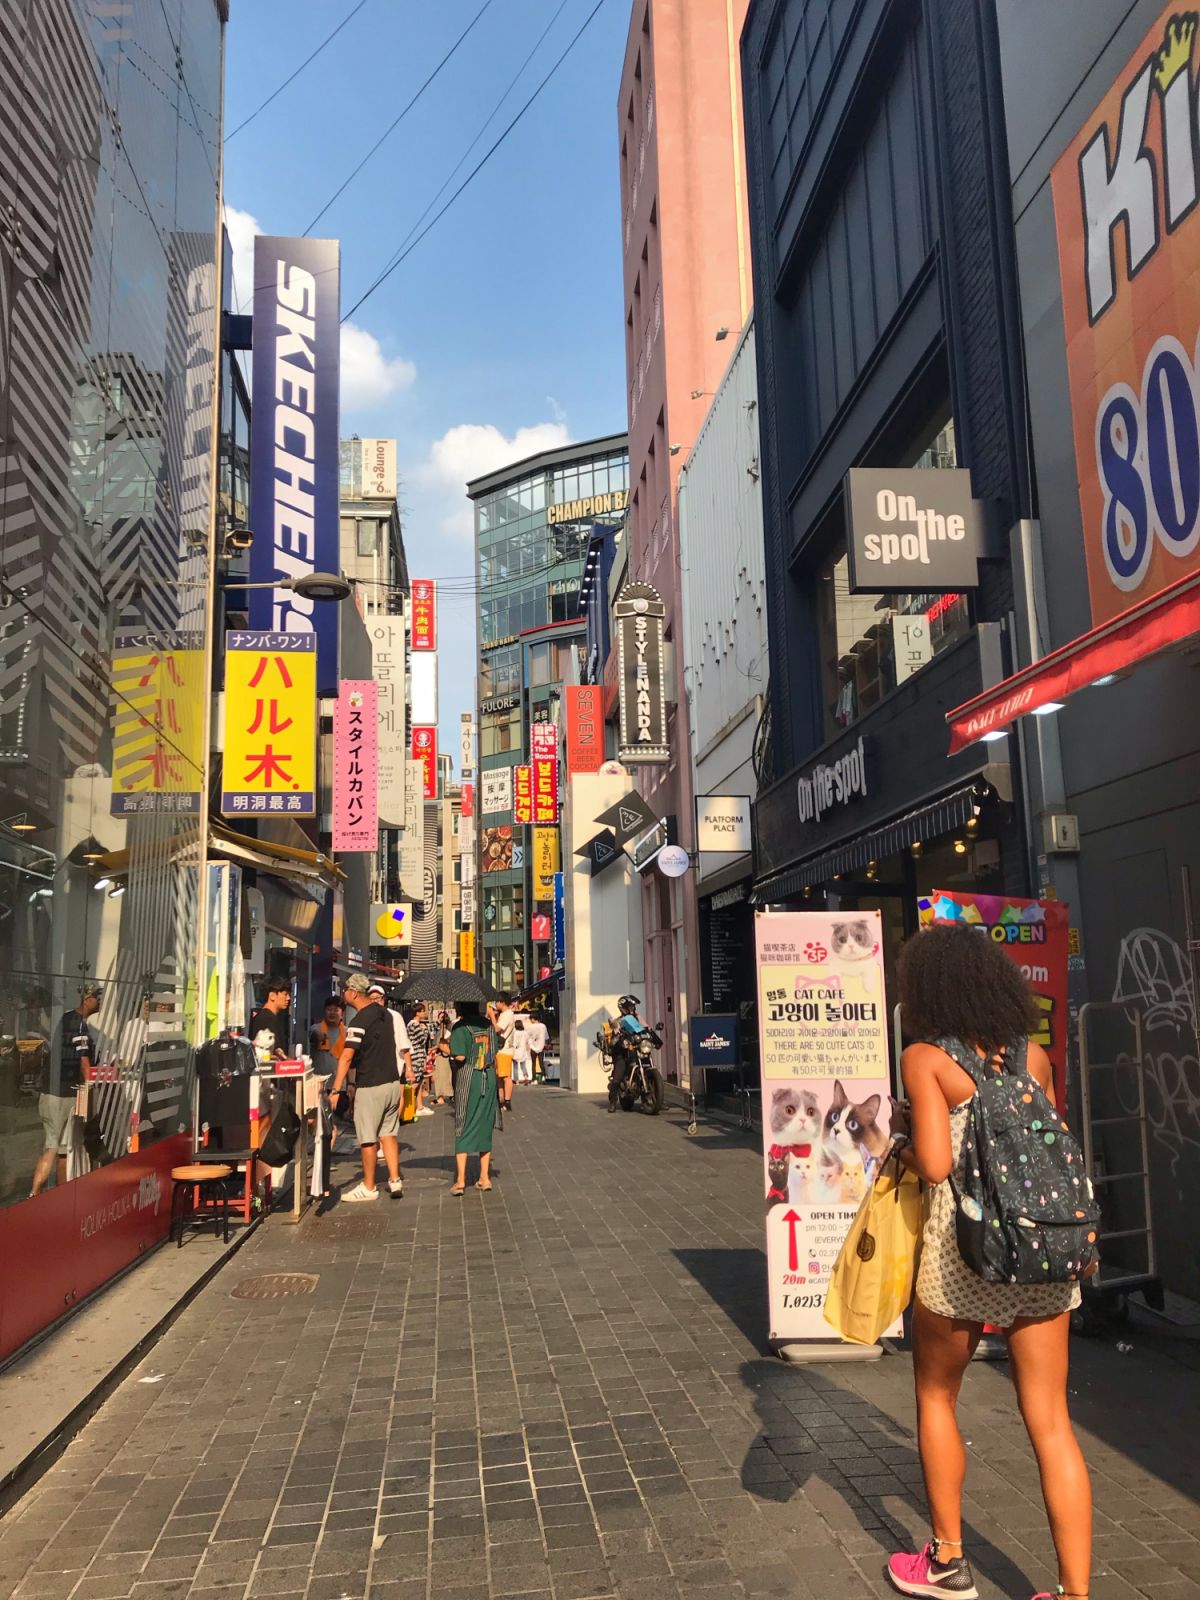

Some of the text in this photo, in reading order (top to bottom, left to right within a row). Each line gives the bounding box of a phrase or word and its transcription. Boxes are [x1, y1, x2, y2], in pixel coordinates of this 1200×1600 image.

[1079, 50, 1200, 327] KI
[373, 440, 388, 479] Lounge
[1096, 330, 1200, 592] 80
[547, 493, 612, 525] CHAMPION
[877, 489, 918, 521] On
[916, 508, 966, 541] the
[864, 531, 930, 564] spot
[635, 616, 652, 742] STYLENANDA
[482, 697, 514, 714] FULORE
[577, 689, 593, 745] SEVEN
[535, 752, 555, 760] Room
[347, 711, 363, 826] スタイルカバン
[798, 735, 867, 824] On the spot
[233, 795, 302, 811] 明洞最高
[704, 815, 743, 824] PLATFORM
[713, 824, 736, 833] PLACE
[990, 923, 1045, 944] OPEN
[808, 948, 828, 962] 3F
[1018, 964, 1049, 983] om
[766, 988, 787, 1001] 명동
[794, 989, 845, 1000] CAT CAFE
[768, 1002, 877, 1022] 고양이 놀이터
[774, 1041, 797, 1049] THERE
[800, 1041, 814, 1049] ARE
[816, 1041, 825, 1049] 50
[827, 1041, 845, 1049] CUTE
[847, 1041, 865, 1049] CATS
[810, 1211, 835, 1220] OPEN
[782, 1274, 806, 1286] 20m
[782, 1293, 827, 1309] T.02)3
